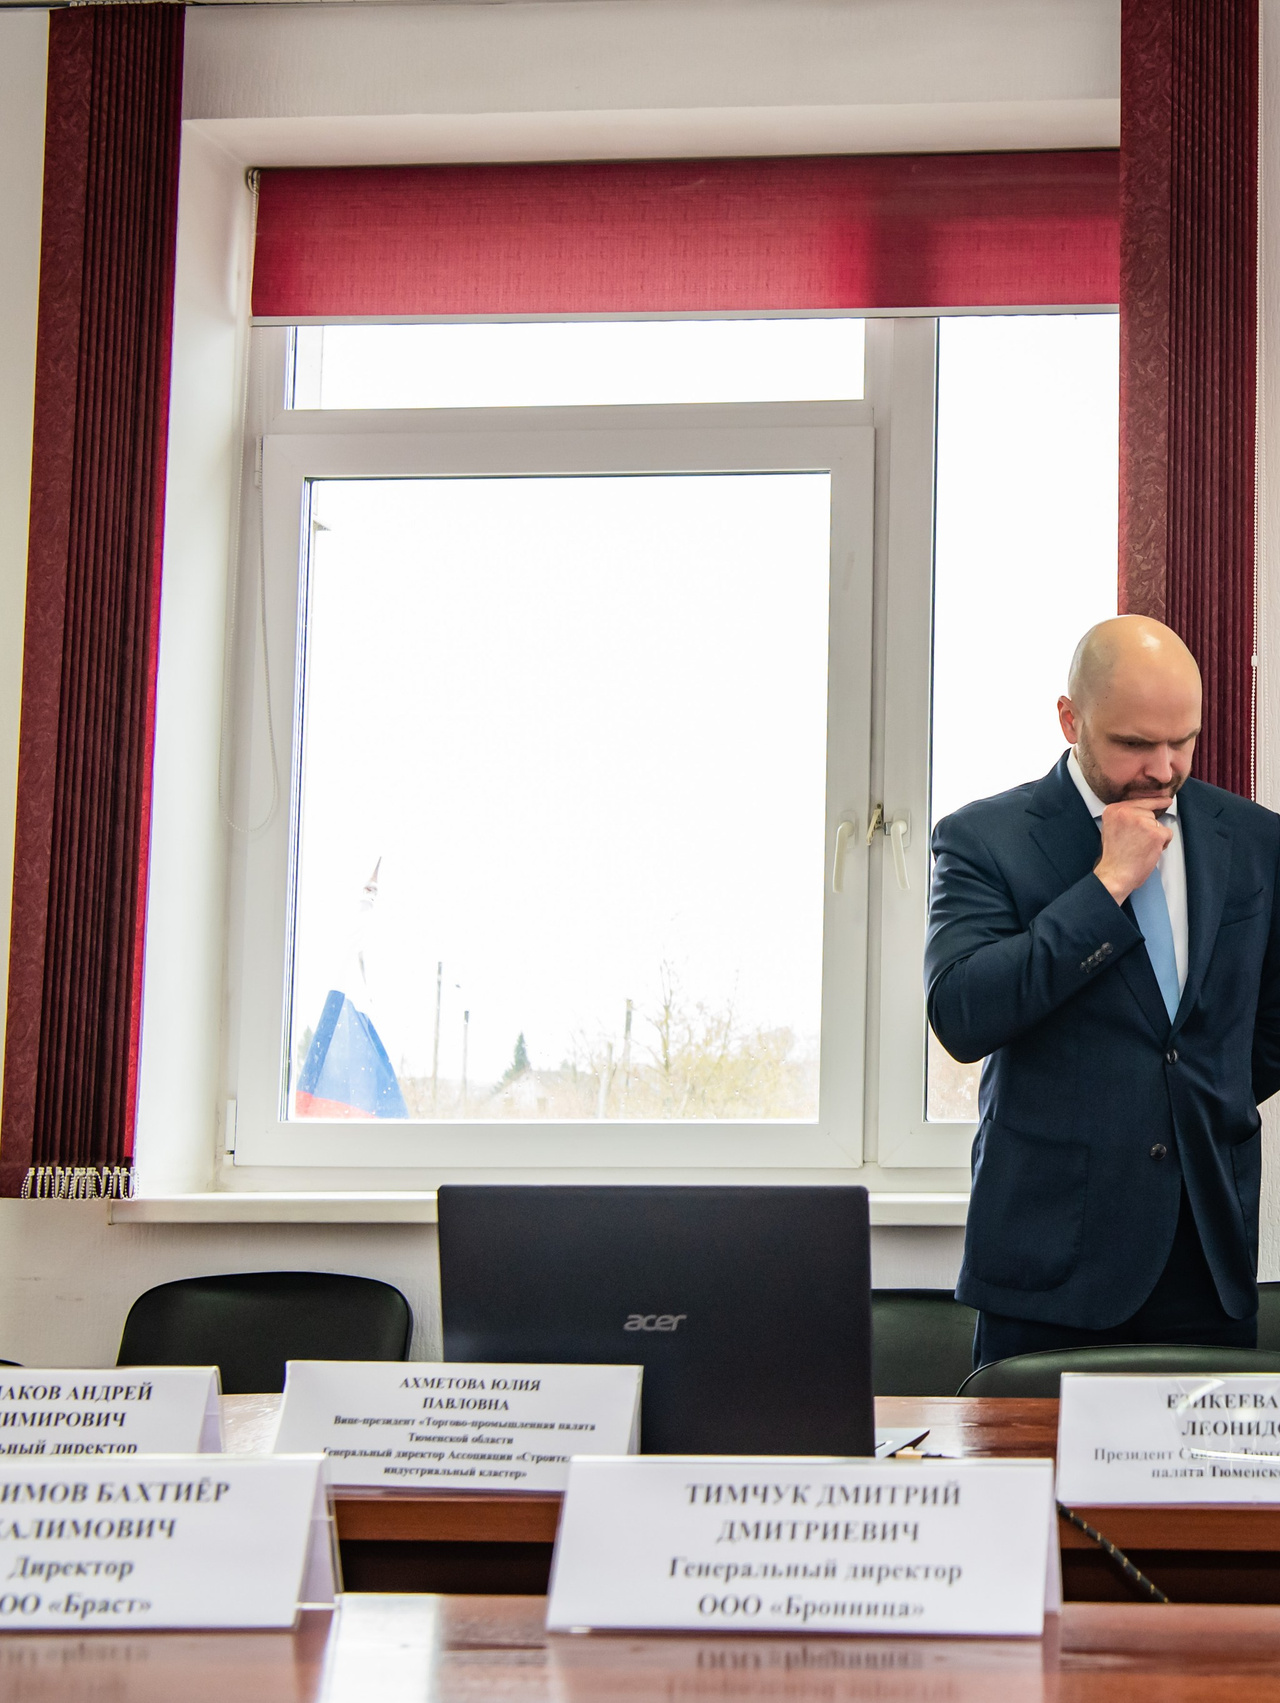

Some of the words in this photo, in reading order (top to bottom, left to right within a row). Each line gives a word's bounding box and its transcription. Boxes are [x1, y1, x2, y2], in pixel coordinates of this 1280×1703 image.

[623, 1314, 688, 1332] acer
[66, 1381, 154, 1404] АНДРЕЙ
[400, 1377, 486, 1390] АХМЕТОВА
[490, 1378, 542, 1391] ЮЛИЯ
[422, 1397, 510, 1411] ПАВЛОВНА
[0, 1411, 126, 1428] ИМИРОВИЧ
[333, 1415, 415, 1427] Вице-президент
[408, 1432, 469, 1443] Тюменской
[471, 1435, 514, 1445] области
[323, 1447, 392, 1459] Генеральный
[394, 1451, 446, 1461] директор
[448, 1451, 513, 1461] Ассоциации
[1094, 1448, 1174, 1463] Президент
[383, 1466, 476, 1478] индустриальный
[1151, 1468, 1205, 1478] палата
[94, 1477, 231, 1503] БАХТИЁР
[686, 1483, 810, 1504] ТИМЧУК
[815, 1480, 961, 1507] ДМИТРИЙ
[0, 1518, 176, 1539] АЛИМОВИЧ
[715, 1520, 920, 1544] ДМИТРИЕВИЧ
[7, 1555, 134, 1582] Директор
[669, 1557, 838, 1583] Генеральный
[844, 1563, 963, 1585] директор
[48, 1592, 152, 1620] «Браст»
[698, 1594, 763, 1616] ООО
[770, 1595, 925, 1622] «Бронница»
